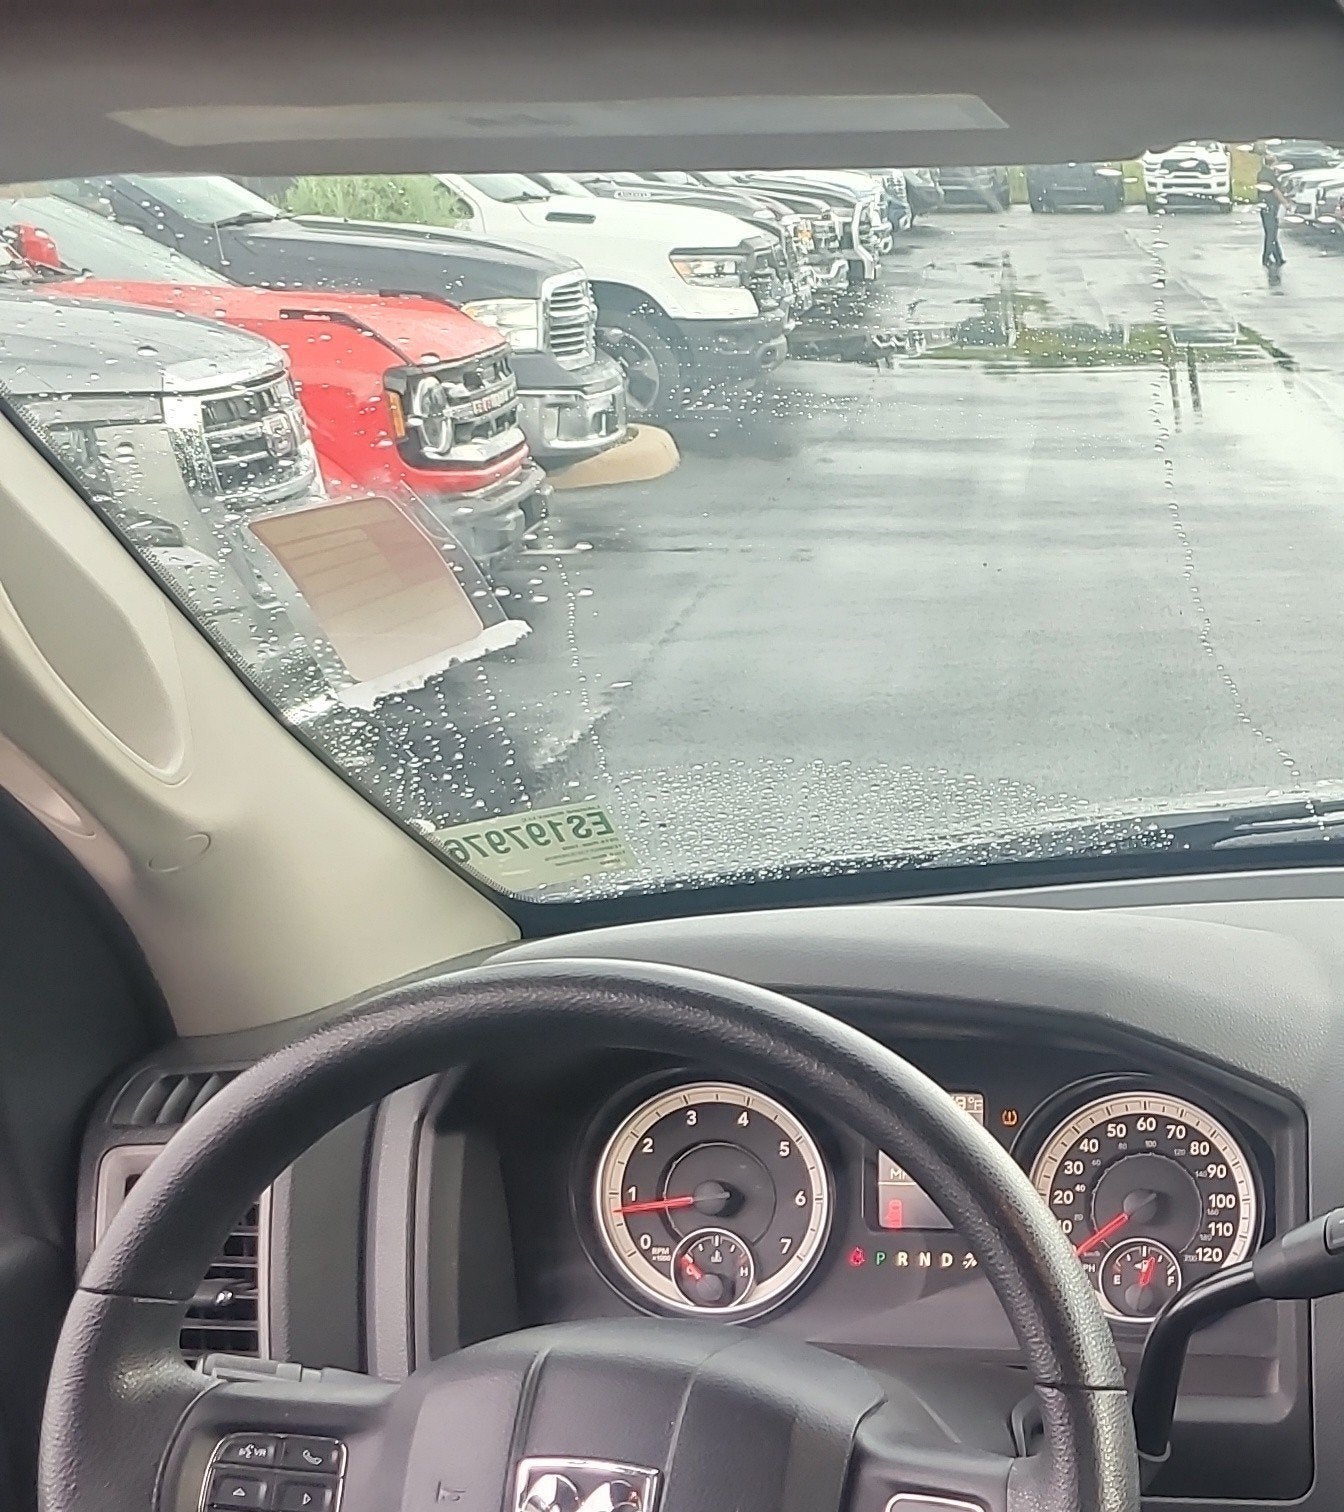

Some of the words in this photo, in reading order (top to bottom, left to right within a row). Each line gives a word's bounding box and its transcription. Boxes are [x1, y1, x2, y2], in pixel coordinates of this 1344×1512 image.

[686, 1110, 696, 1126] 3
[738, 1112, 749, 1126] 4
[1136, 1117, 1156, 1131] 60
[1106, 1124, 1126, 1138] 50
[1166, 1125, 1186, 1140] 70
[642, 1138, 654, 1152] 2
[779, 1142, 790, 1156] 5
[1079, 1138, 1099, 1152] 40
[1190, 1141, 1210, 1156] 80
[1064, 1160, 1084, 1175] 30
[1206, 1164, 1227, 1178] 90
[628, 1186, 637, 1202] 1
[1075, 1184, 1086, 1192] 40
[795, 1191, 806, 1206] 6
[1052, 1190, 1074, 1204] 20
[1208, 1194, 1236, 1208] 100
[1208, 1222, 1233, 1237] 110
[640, 1234, 652, 1250] 0
[780, 1239, 792, 1254] 7
[876, 1252, 886, 1266] P
[898, 1252, 908, 1266] R
[920, 1252, 931, 1267] N
[941, 1253, 953, 1267] D
[1196, 1248, 1223, 1262] 120
[740, 1267, 748, 1277] H
[1114, 1274, 1121, 1285] E
[1168, 1276, 1175, 1286] F
